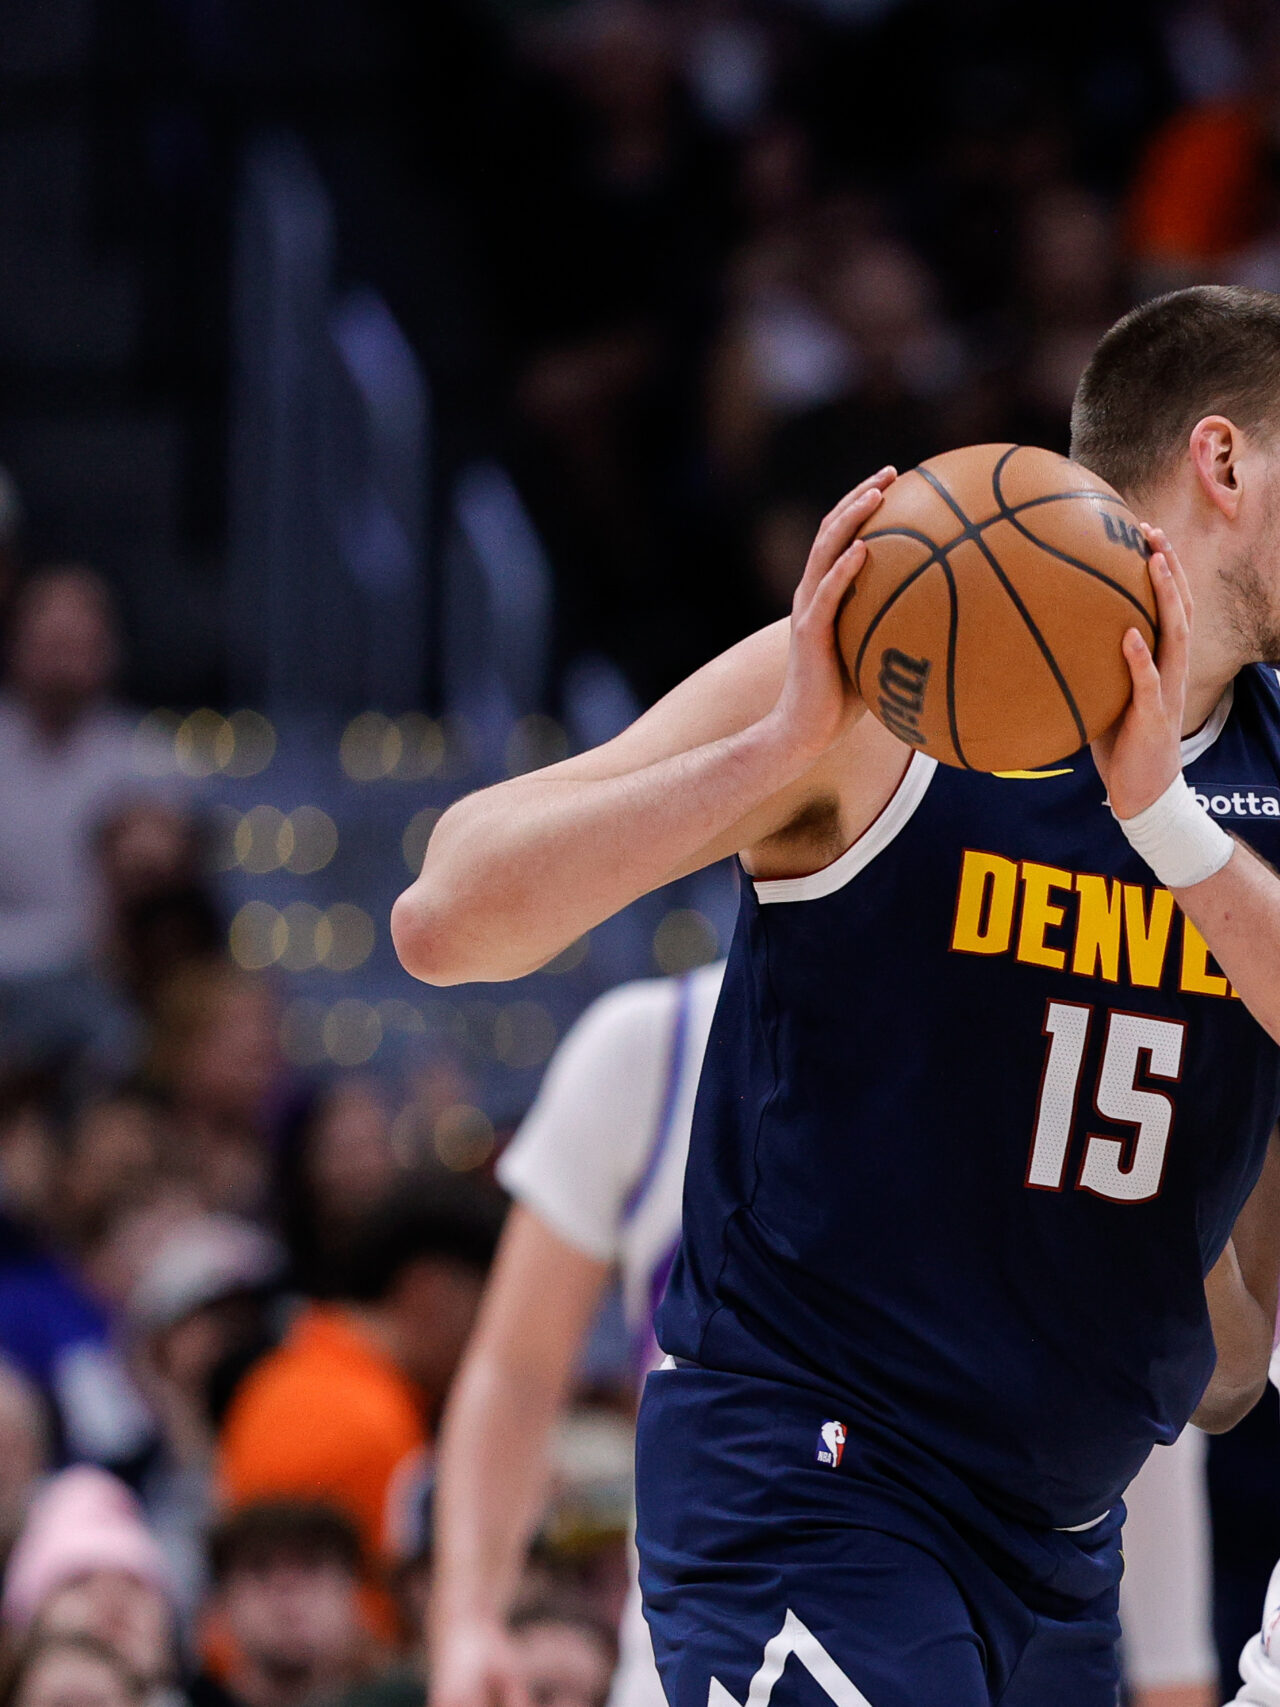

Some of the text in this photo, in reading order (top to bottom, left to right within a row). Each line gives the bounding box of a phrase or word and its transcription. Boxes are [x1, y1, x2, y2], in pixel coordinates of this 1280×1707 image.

[878, 648, 932, 744] Wil
[1188, 786, 1280, 816] botta
[949, 848, 1243, 1000] DENVE
[1024, 998, 1188, 1205] 15
